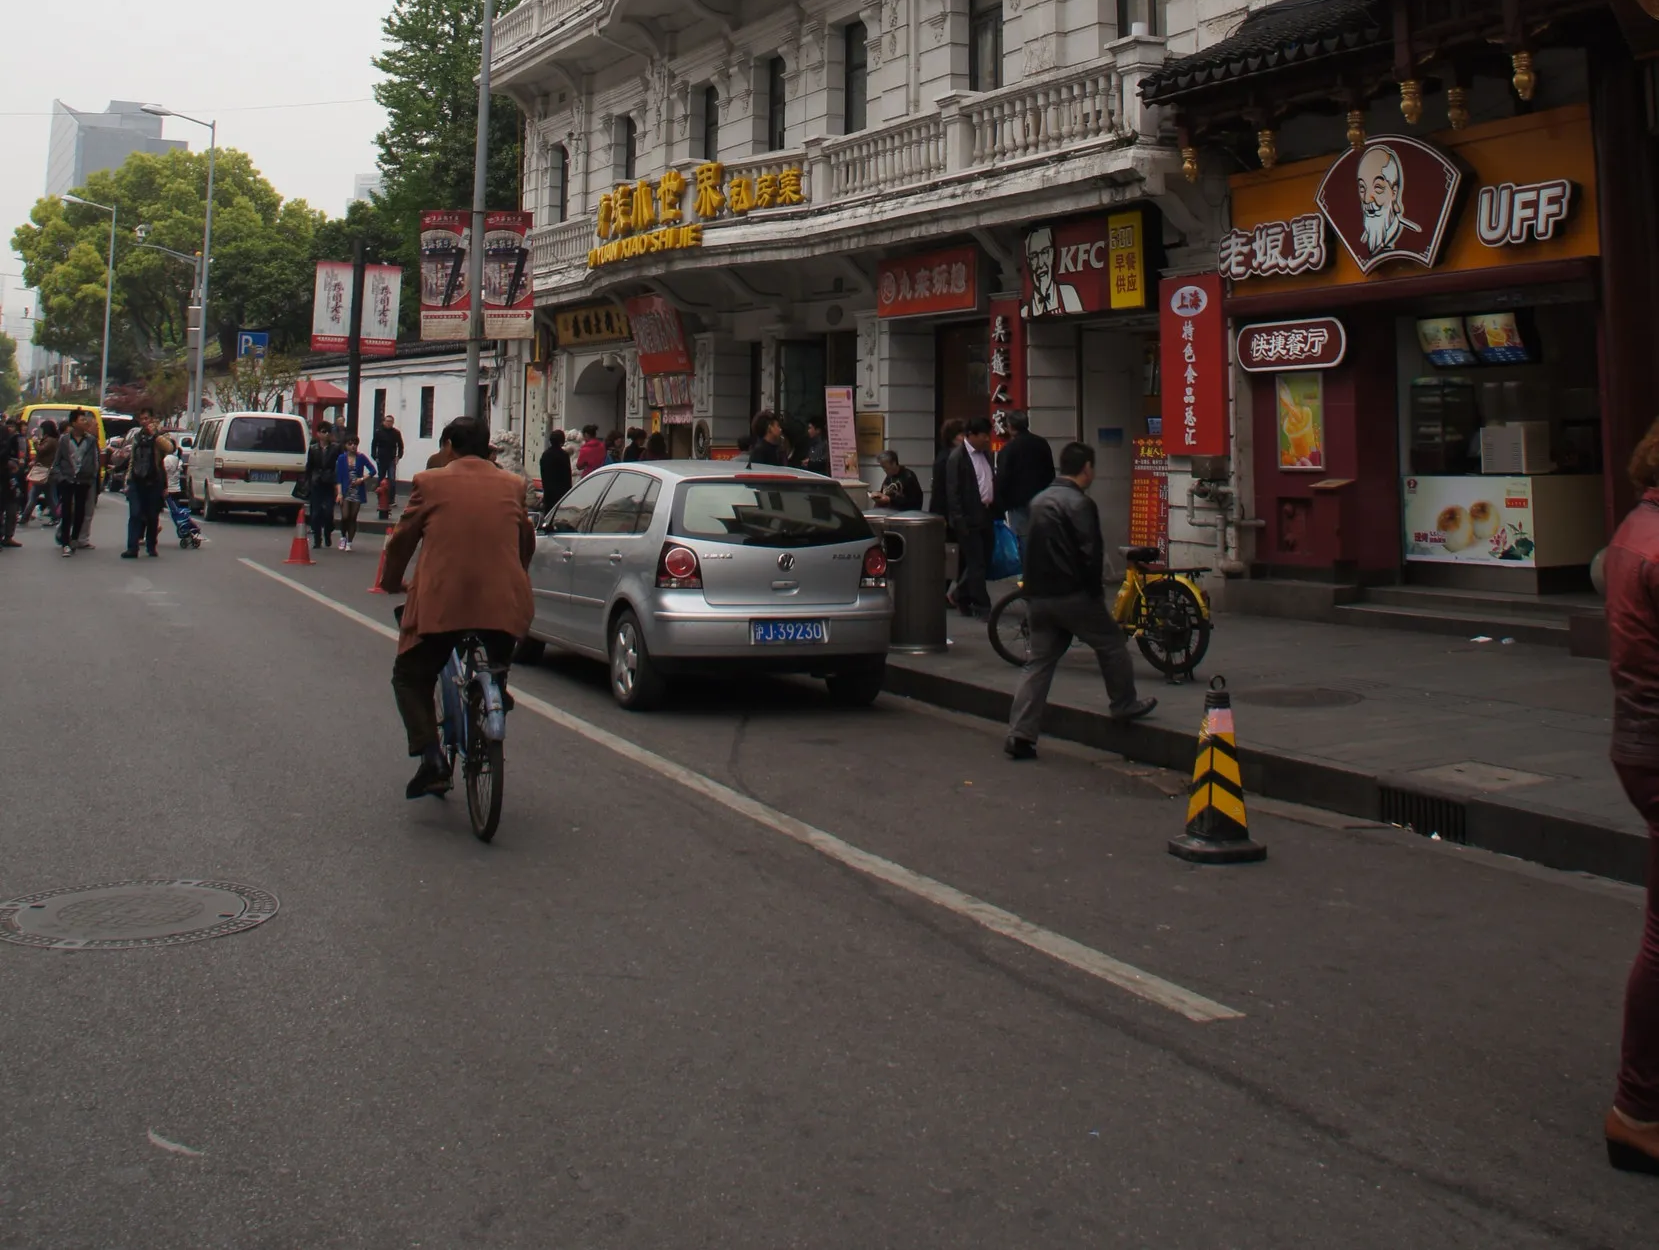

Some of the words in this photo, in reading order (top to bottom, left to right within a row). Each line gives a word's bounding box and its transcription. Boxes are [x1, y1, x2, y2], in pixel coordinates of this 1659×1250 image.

[1478, 184, 1569, 246] UFF
[620, 234, 648, 259] XIAO
[650, 228, 675, 252] SHI
[676, 224, 702, 250] JIE
[1058, 241, 1105, 274] KFC
[1220, 218, 1325, 276] 老娘舅
[1115, 252, 1137, 272] 早餐
[1116, 274, 1137, 295] 供应
[1177, 290, 1202, 310] 上海
[1251, 329, 1326, 359] 快捷餐厅
[1182, 320, 1198, 446] 特色食品总汇
